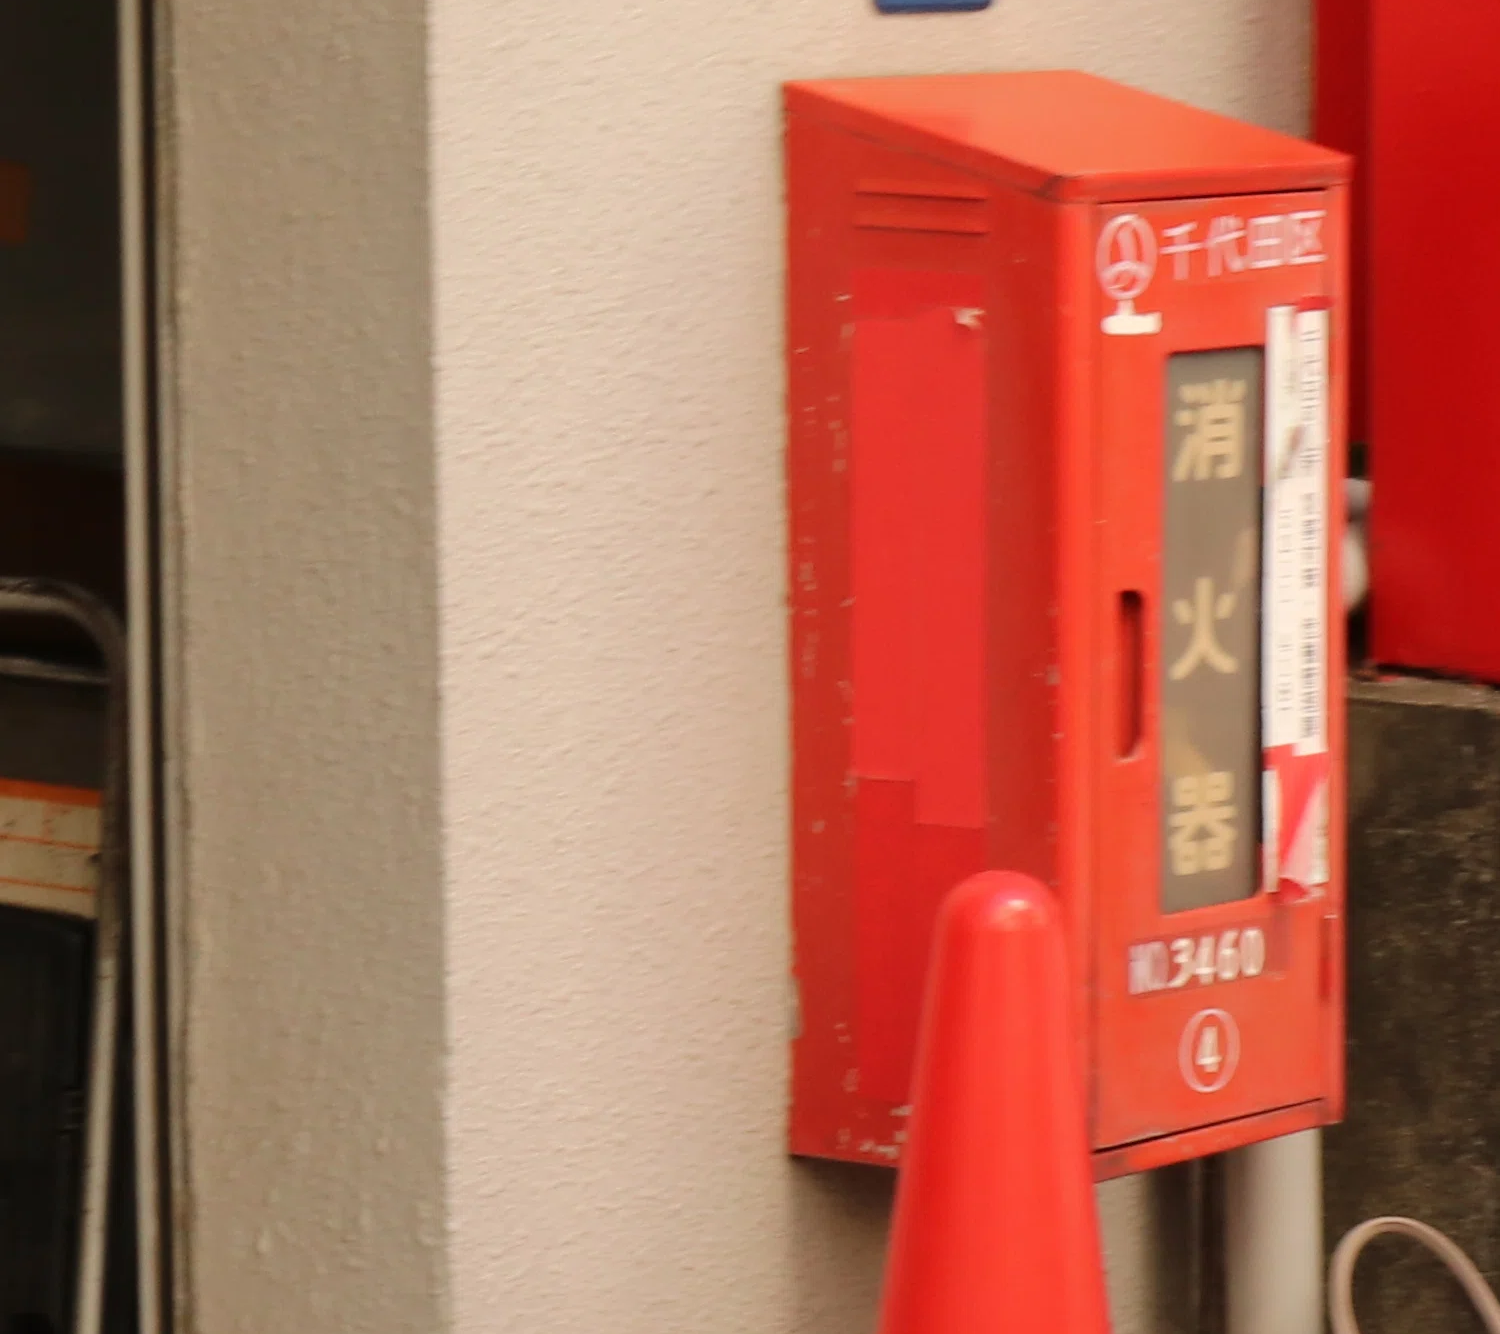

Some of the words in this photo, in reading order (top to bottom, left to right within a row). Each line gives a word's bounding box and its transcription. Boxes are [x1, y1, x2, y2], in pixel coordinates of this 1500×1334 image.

[1160, 210, 1327, 280] 千代田区
[1169, 377, 1246, 873] 消火器
